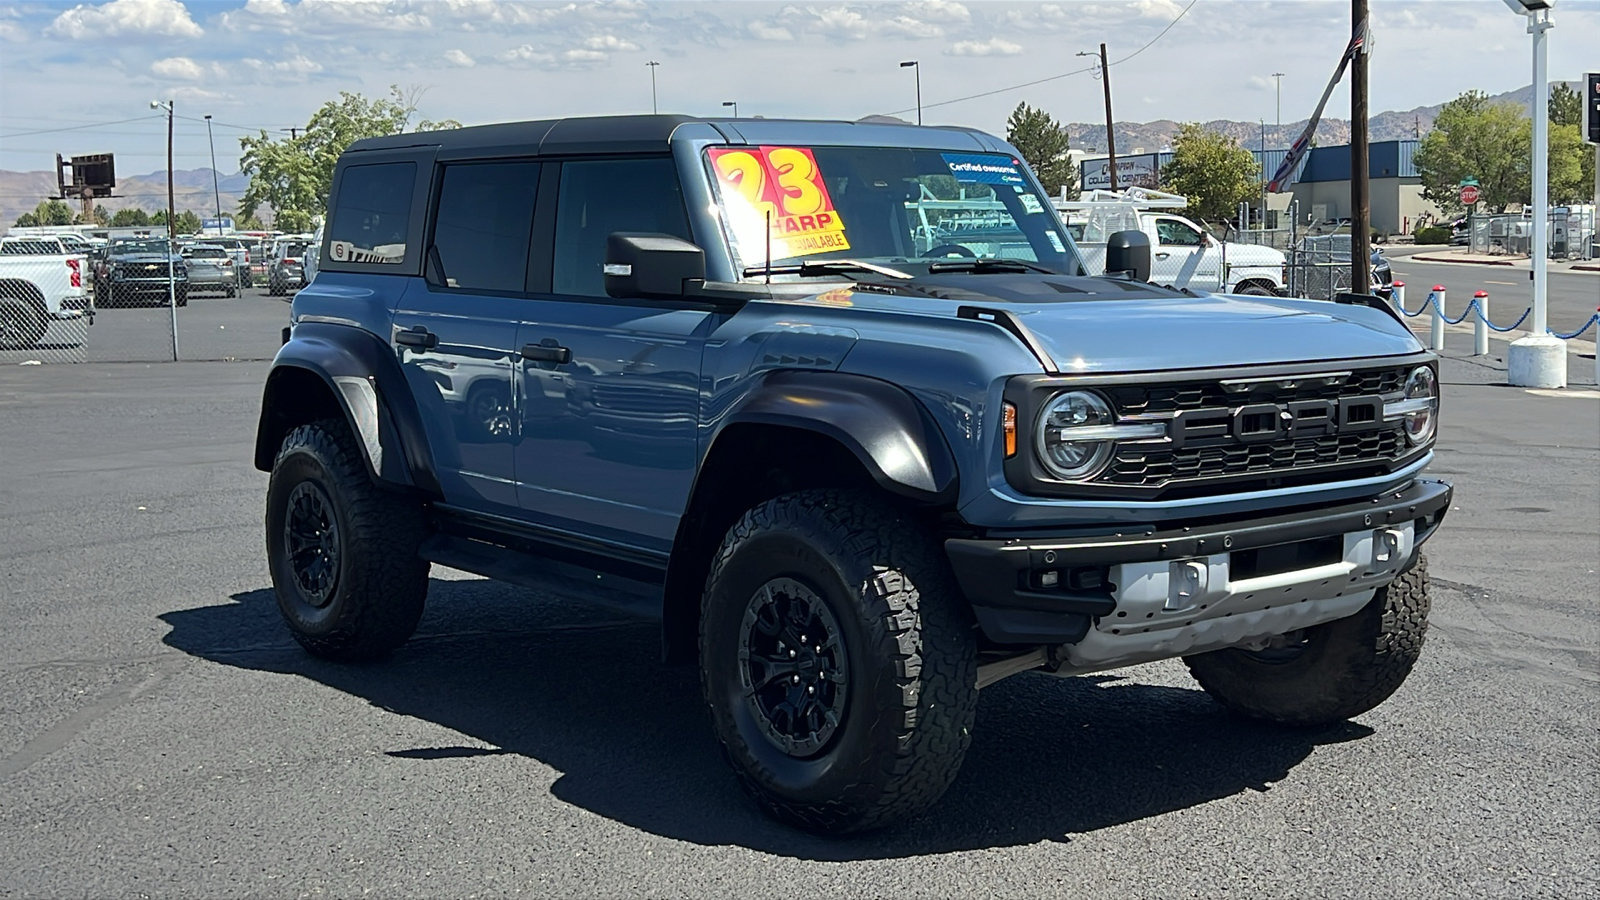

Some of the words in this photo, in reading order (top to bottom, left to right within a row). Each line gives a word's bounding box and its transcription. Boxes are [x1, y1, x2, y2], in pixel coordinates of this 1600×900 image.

[949, 162, 982, 172] Certified
[716, 148, 827, 216] 23
[1088, 175, 1121, 185] COLLISN
[1461, 191, 1477, 199] STOP
[769, 213, 832, 234] HARP
[795, 233, 845, 251] VAILABLE
[1173, 394, 1384, 450] FORD
